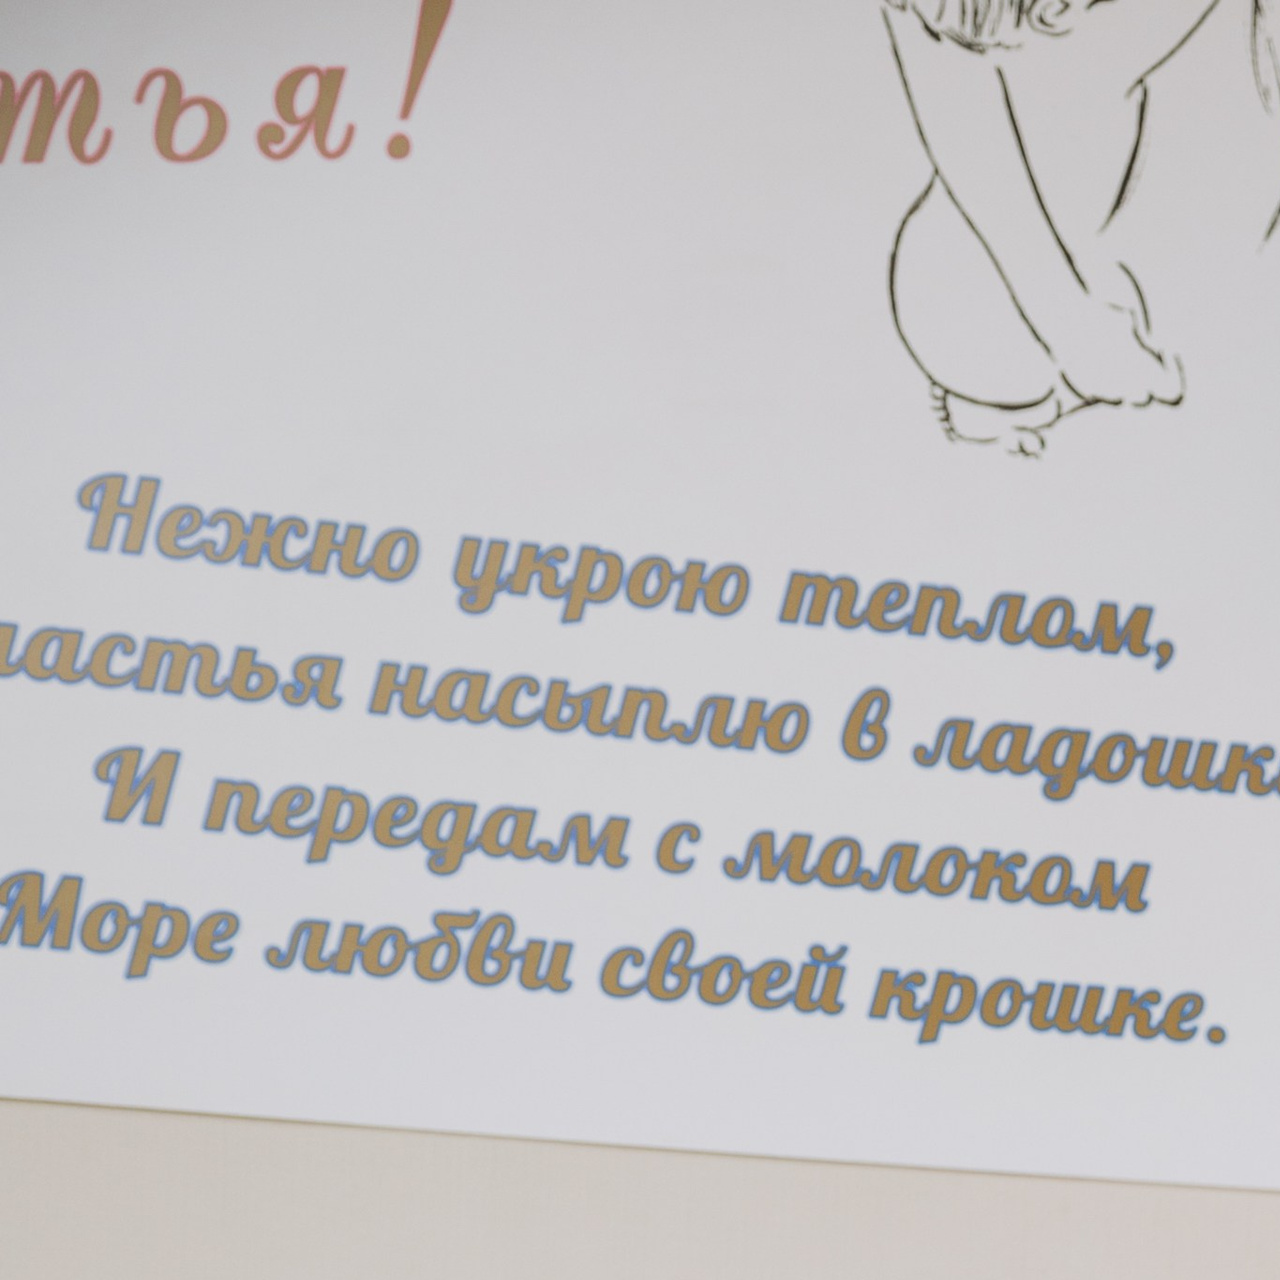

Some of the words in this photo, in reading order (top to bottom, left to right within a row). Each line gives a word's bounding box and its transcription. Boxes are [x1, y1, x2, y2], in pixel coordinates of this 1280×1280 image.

[76, 473, 420, 583] Нежно
[452, 536, 751, 624] укрою
[778, 570, 1175, 671] теплом,
[368, 661, 811, 755] насыплю
[840, 686, 892, 762] в
[93, 745, 182, 827] И
[202, 778, 631, 877] передам
[655, 821, 702, 875] с
[722, 830, 1151, 914] молоком
[0, 869, 241, 980] Море
[264, 909, 574, 994] любви
[599, 928, 848, 1016] своей
[868, 968, 1227, 1045] крошке.
